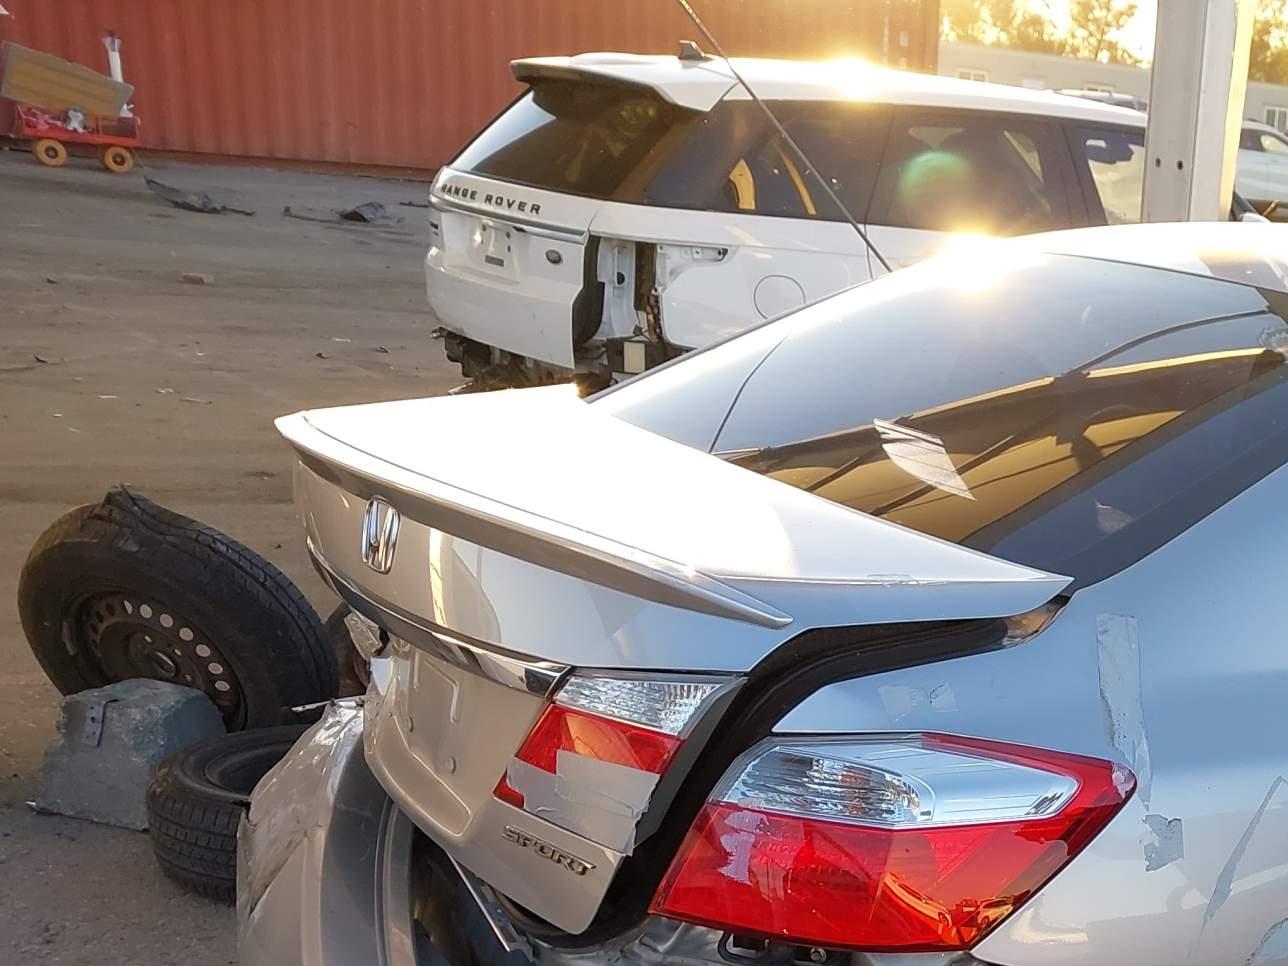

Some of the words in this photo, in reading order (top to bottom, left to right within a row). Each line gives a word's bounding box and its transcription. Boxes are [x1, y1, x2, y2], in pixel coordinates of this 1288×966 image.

[440, 183, 478, 200] RANGE
[484, 193, 542, 215] ROVER
[501, 823, 597, 876] SPORT
